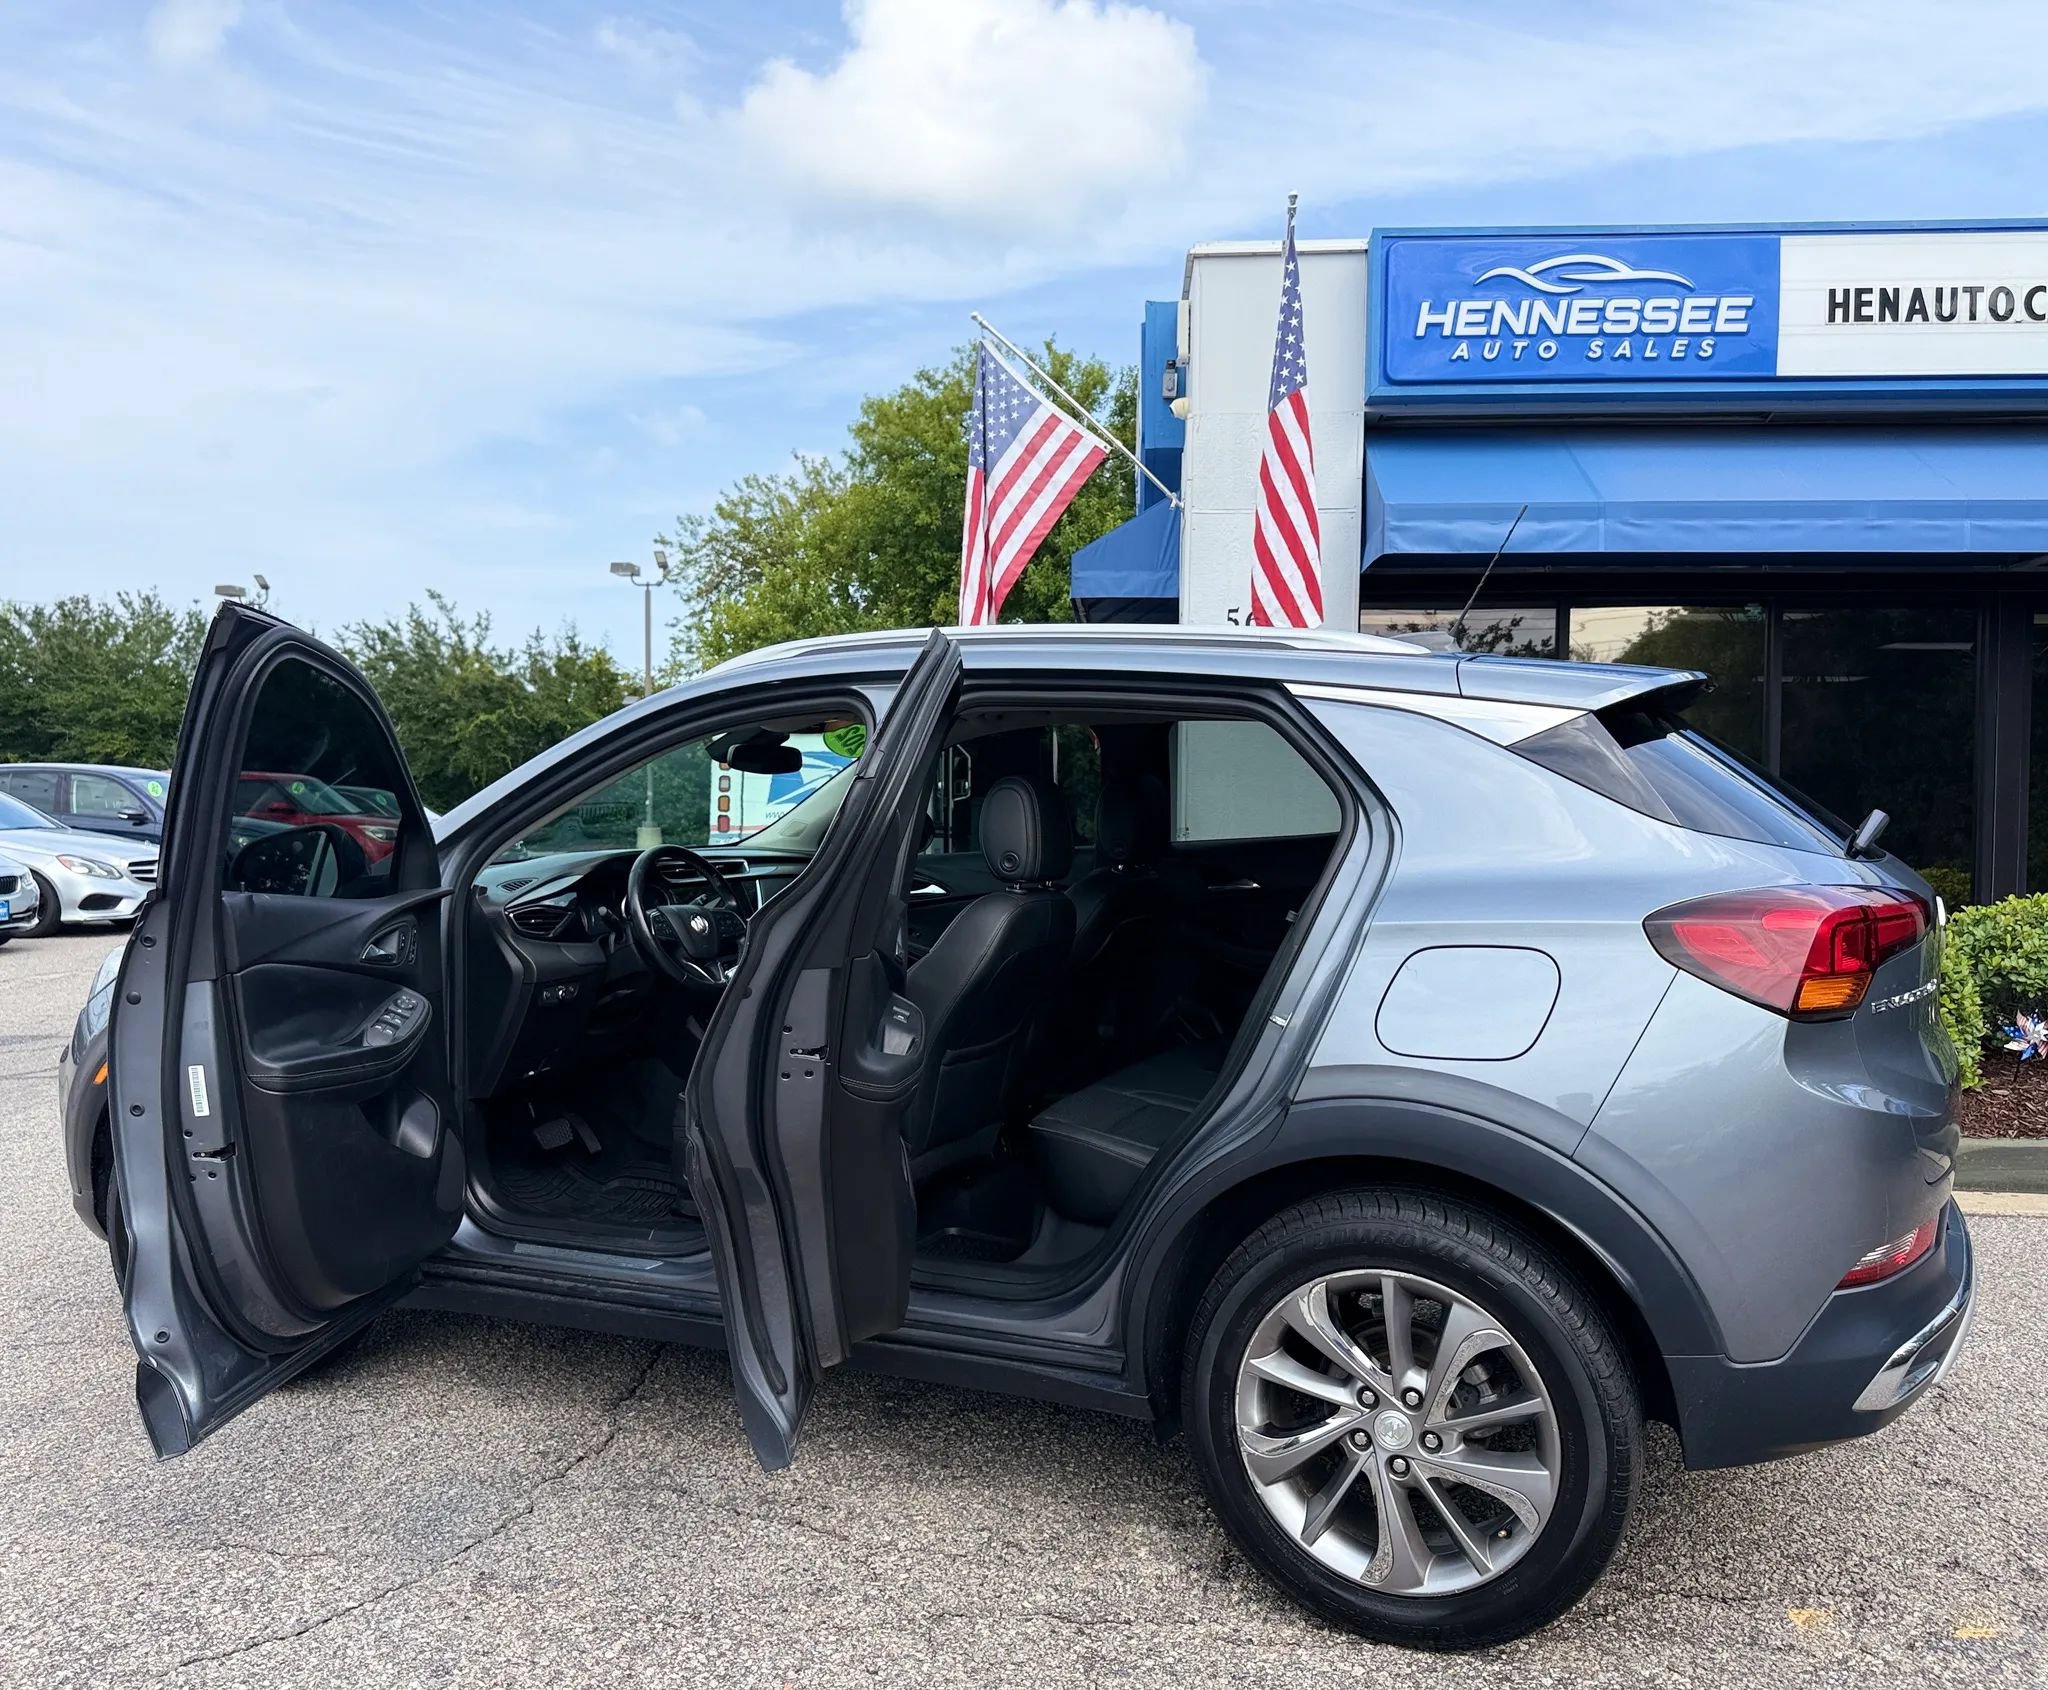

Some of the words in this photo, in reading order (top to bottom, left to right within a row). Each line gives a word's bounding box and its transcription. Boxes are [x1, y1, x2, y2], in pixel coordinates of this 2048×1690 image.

[1415, 296, 1754, 338] HENNESSEE
[1451, 340, 1558, 361] AUTO
[1588, 337, 1716, 361] SALES
